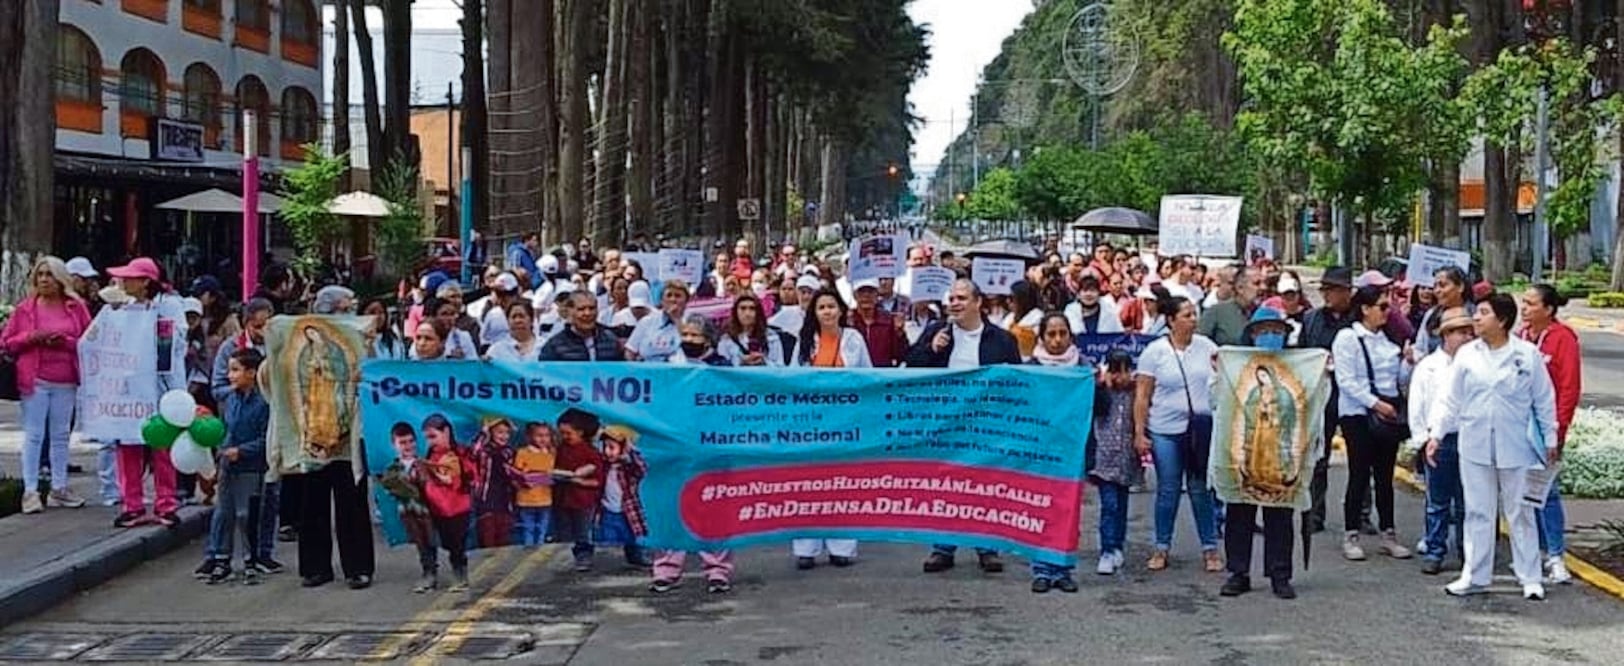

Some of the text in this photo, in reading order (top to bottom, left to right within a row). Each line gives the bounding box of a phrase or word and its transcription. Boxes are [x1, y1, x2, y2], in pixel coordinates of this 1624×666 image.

[371, 376, 652, 403] ¡Con los niños NO!
[694, 392, 758, 406] Estado
[764, 392, 787, 405] de
[731, 410, 823, 424] presente en la
[700, 427, 860, 445] Marcha Nacional
